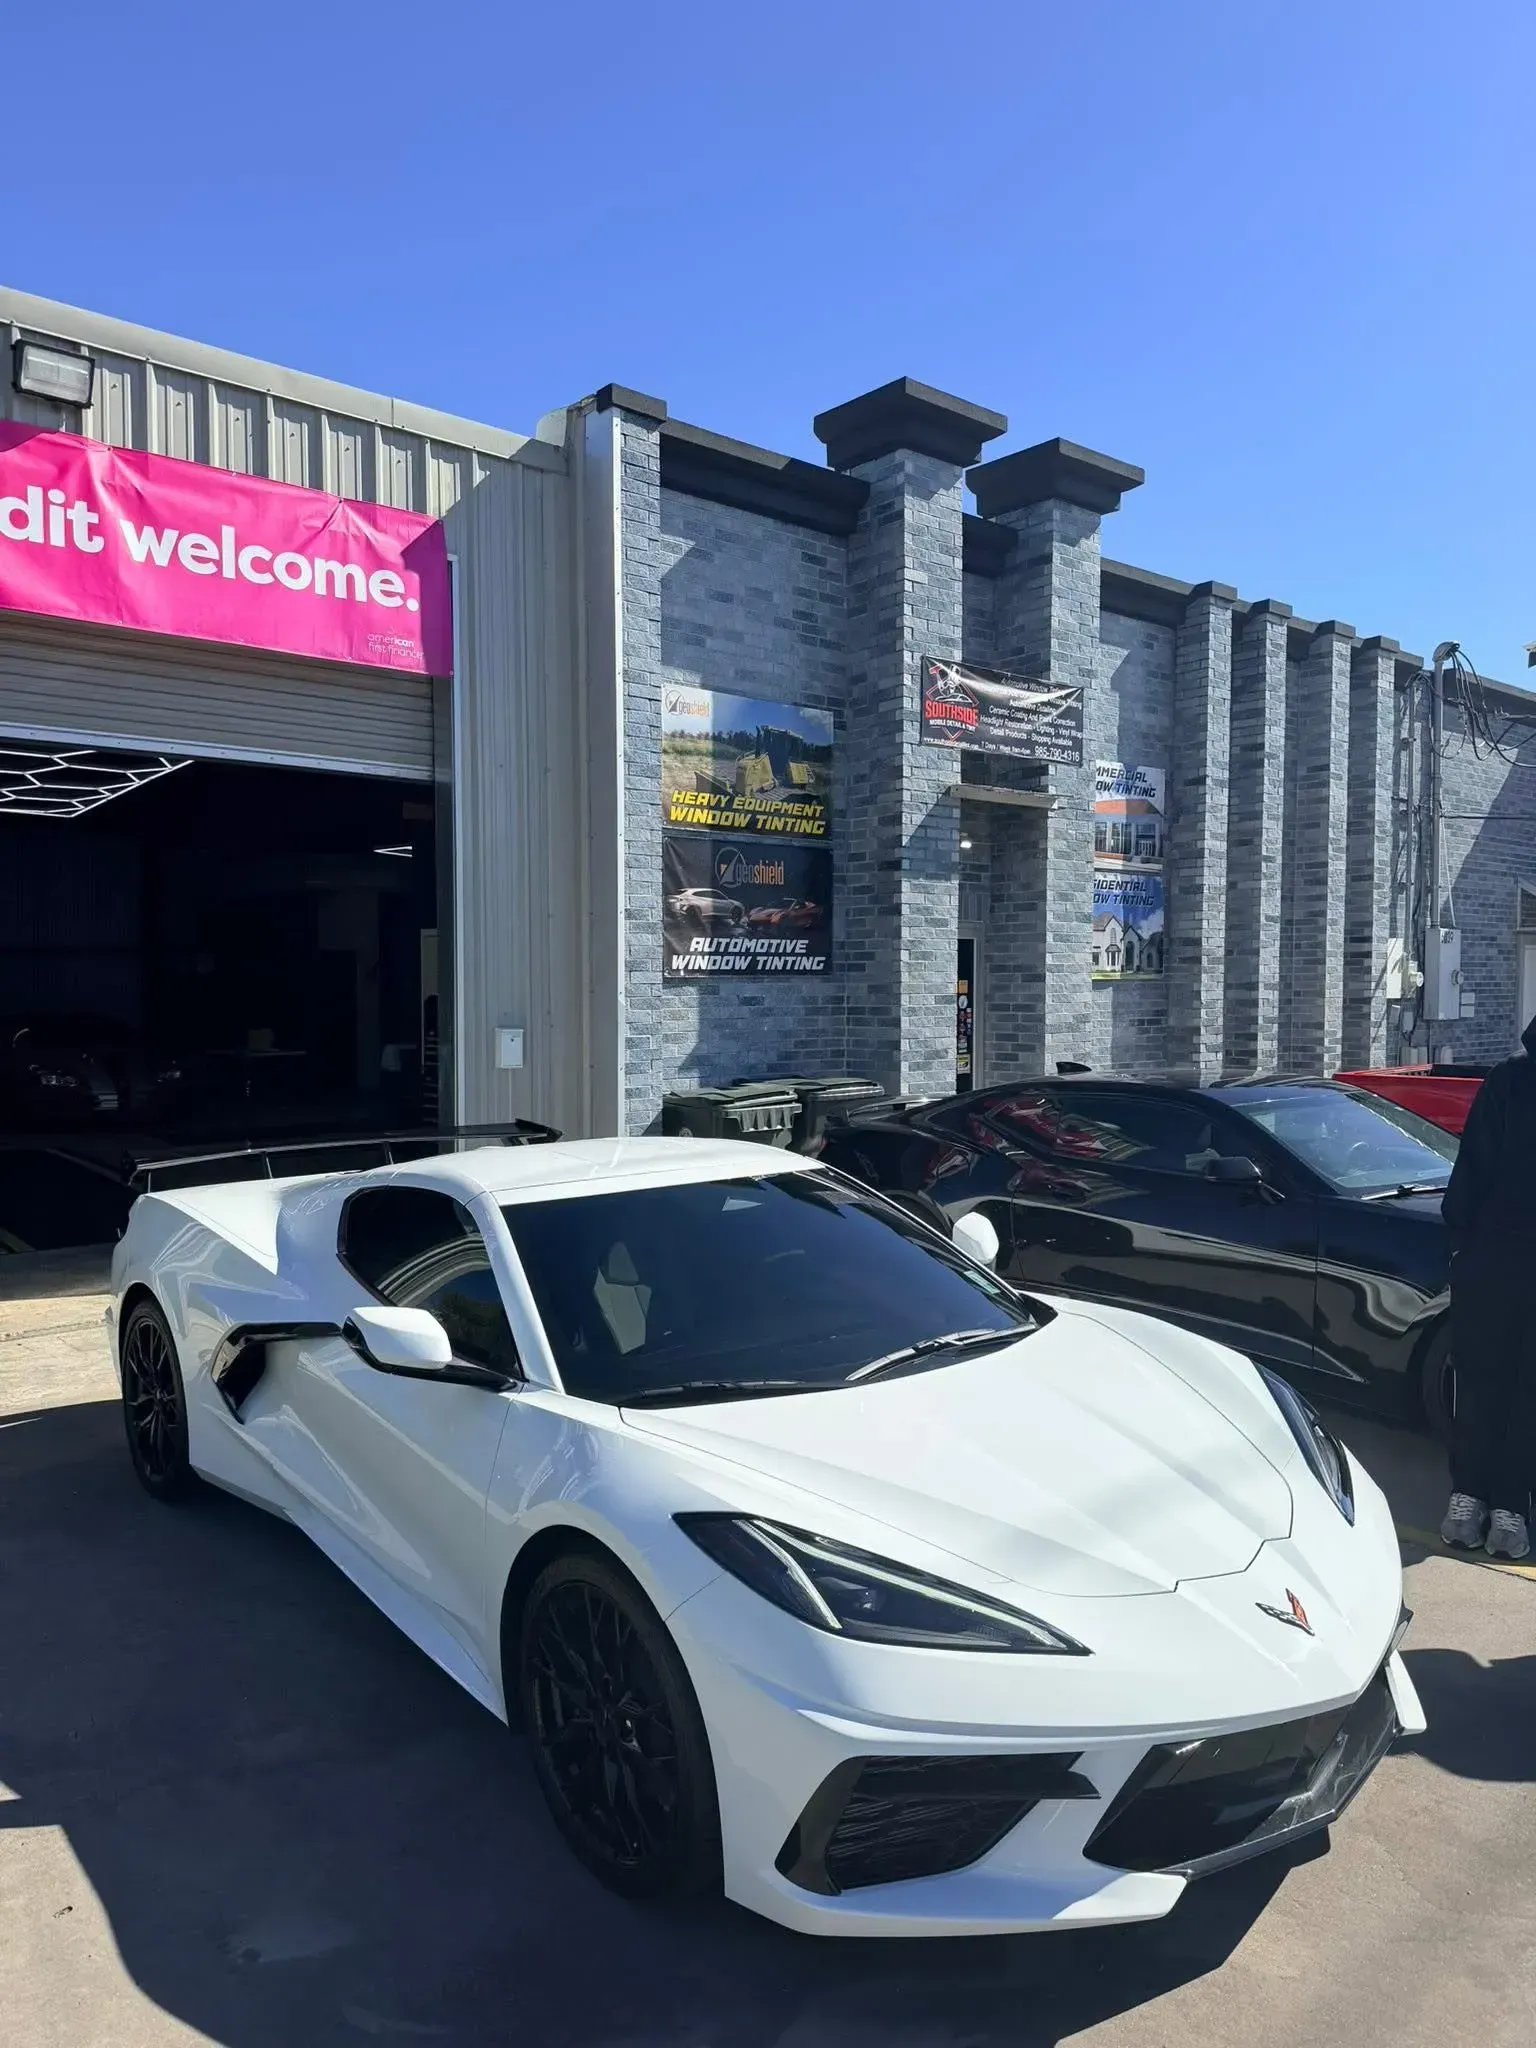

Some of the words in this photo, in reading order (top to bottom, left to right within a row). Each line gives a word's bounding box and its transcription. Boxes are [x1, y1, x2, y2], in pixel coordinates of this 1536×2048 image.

[0, 486, 104, 554] dit
[118, 519, 420, 612] welcome.
[367, 633, 414, 647] american
[368, 642, 386, 653] first
[925, 700, 979, 728] SOUTHSIDE
[989, 705, 1010, 716] Ceramic
[1011, 710, 1028, 721] Coating
[1028, 713, 1038, 721] And
[1053, 717, 1076, 726] Correction
[980, 715, 1003, 727] Headlight
[1004, 719, 1032, 730] Restoration
[1058, 728, 1070, 737] Vinyl
[989, 726, 1004, 736] Detail
[1005, 730, 1027, 740] Products
[1031, 733, 1051, 745] Shipping
[1052, 737, 1073, 746] Available
[1115, 783, 1157, 798] TINTING
[671, 790, 730, 809] HEAVY
[732, 795, 825, 818] EQUIPMENT
[669, 805, 752, 829] WINDOW
[755, 814, 826, 835] TINTING
[735, 860, 785, 885] geoshield
[1113, 894, 1155, 906] TINTING
[689, 936, 809, 954] AUTOMOTIVE
[671, 955, 753, 970] WINDOW
[756, 956, 826, 971] TINTING
